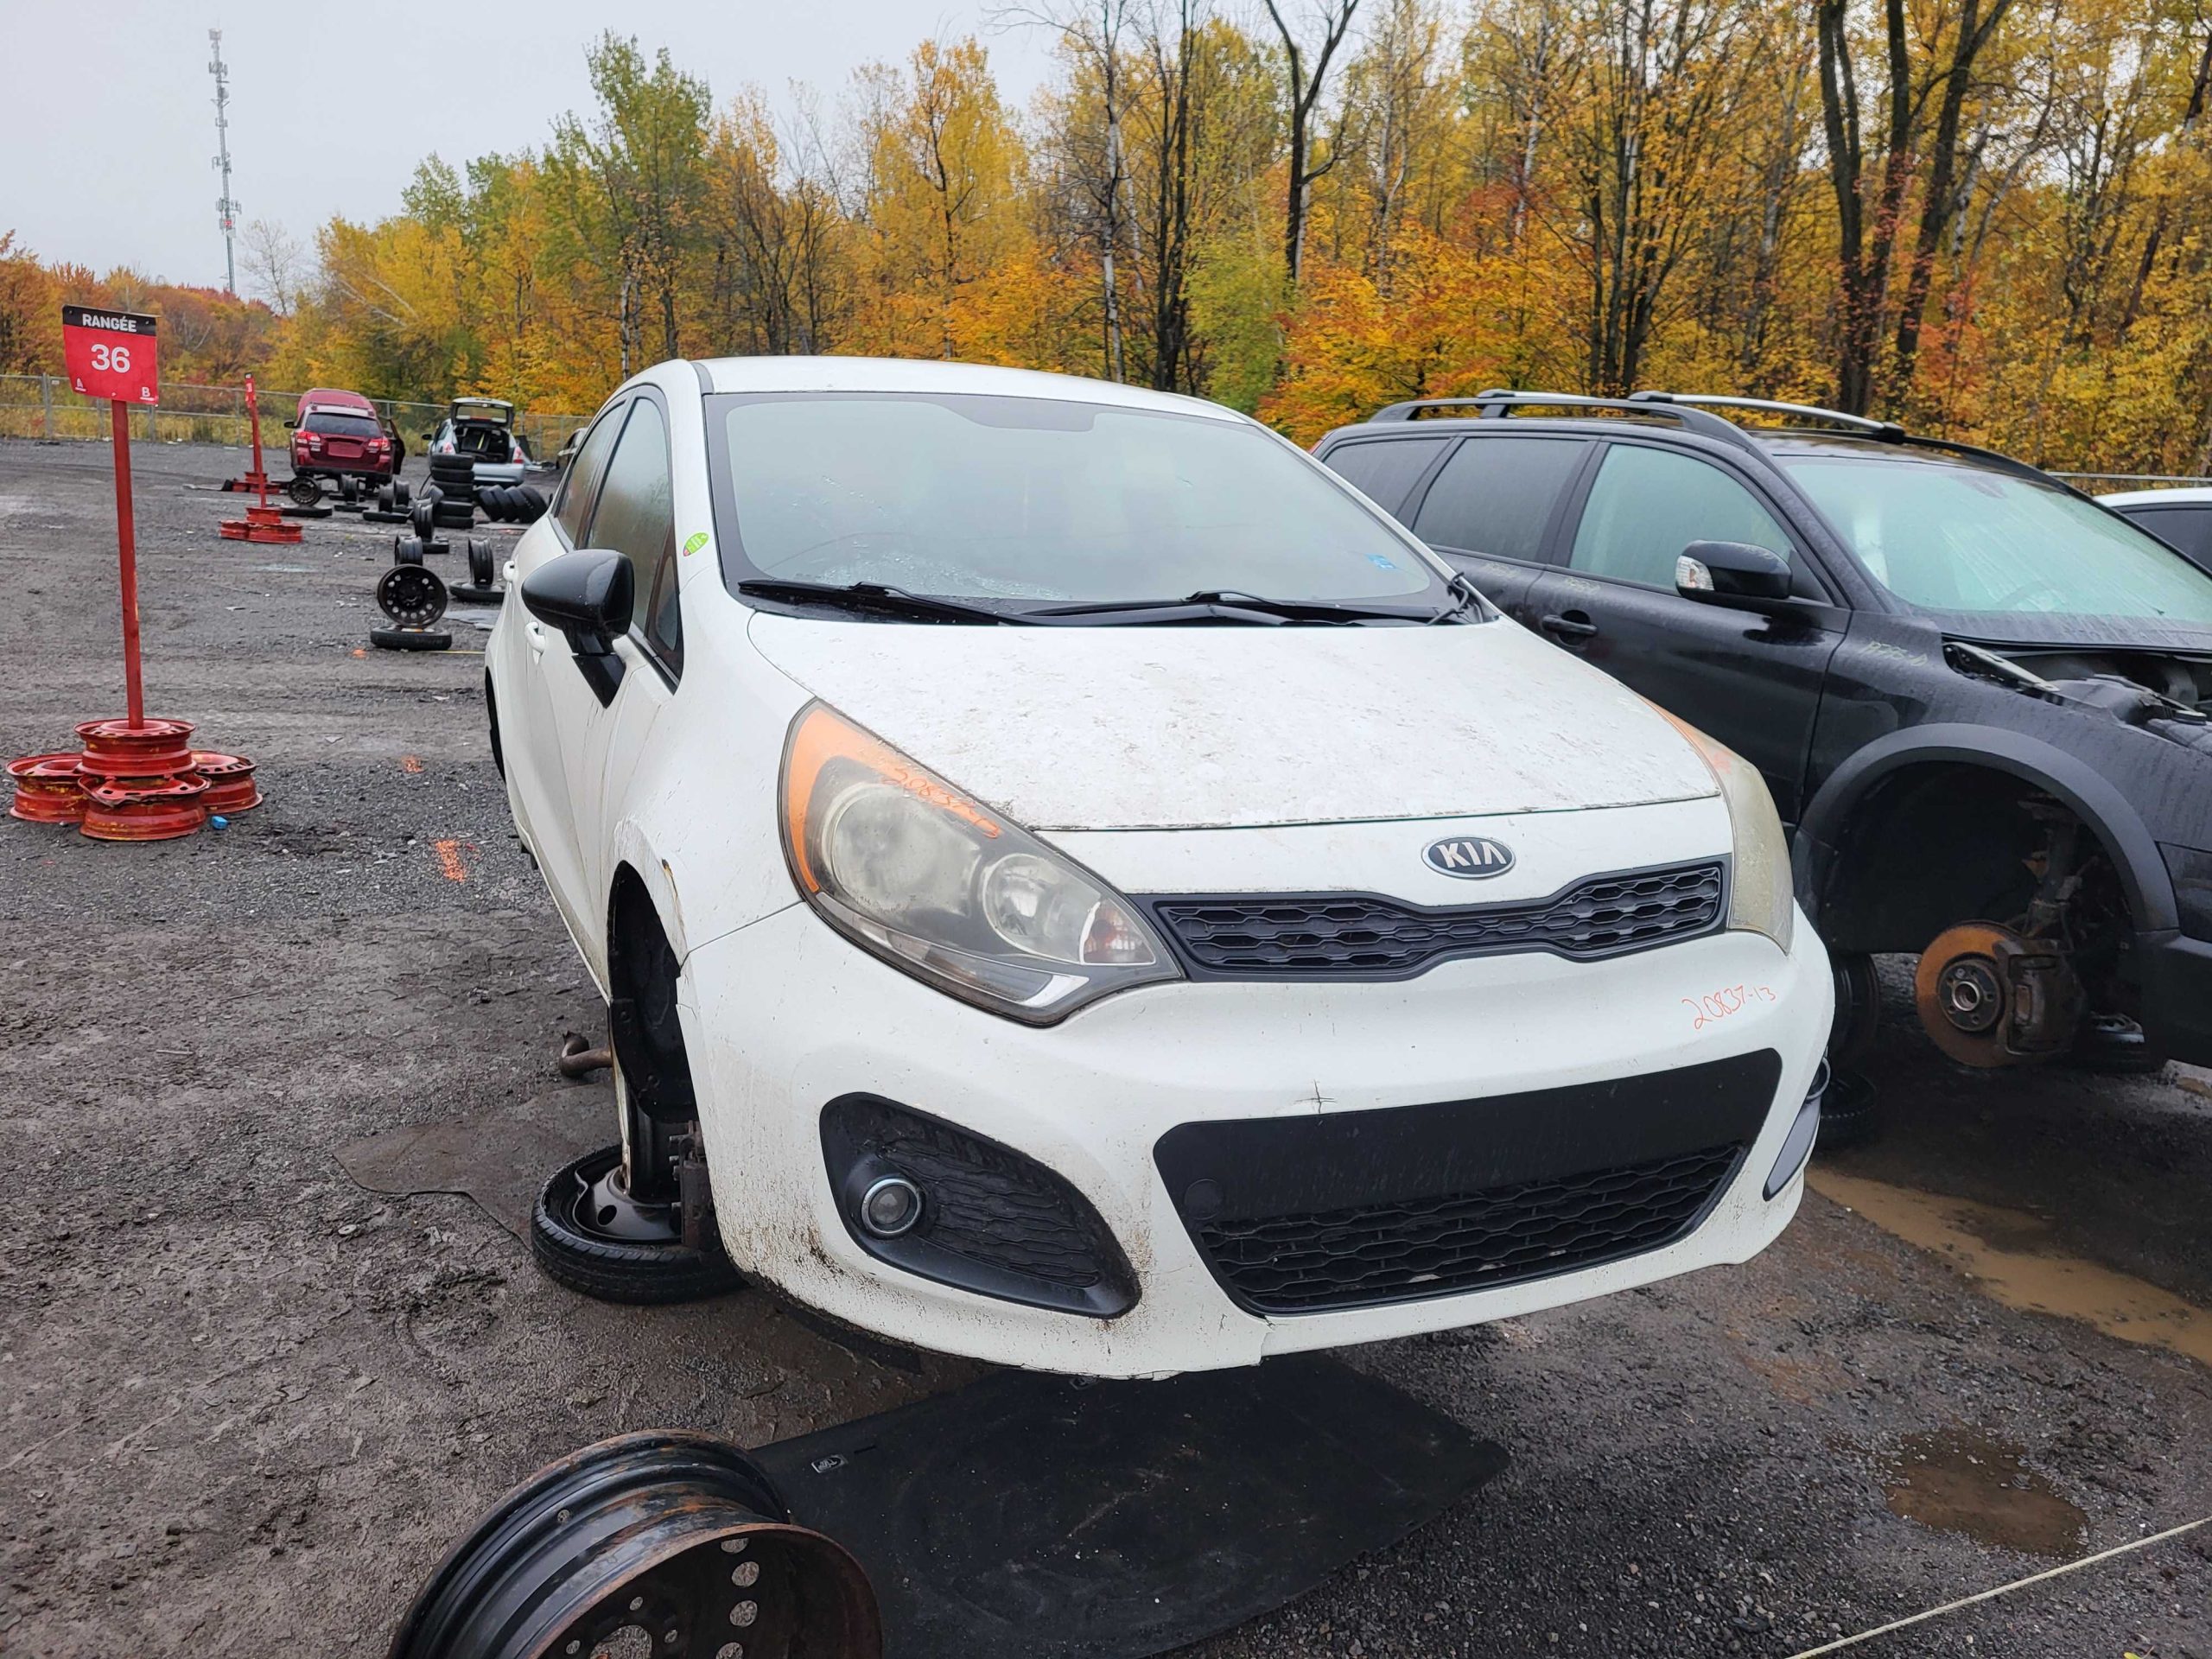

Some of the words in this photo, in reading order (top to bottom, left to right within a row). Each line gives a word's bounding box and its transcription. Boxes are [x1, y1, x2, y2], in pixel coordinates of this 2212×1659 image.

[82, 314, 137, 333] RANGÉE
[91, 344, 130, 373] 36
[142, 386, 150, 397] B
[1435, 841, 1507, 868] KIA
[1681, 985, 1777, 1030] 20837-13
